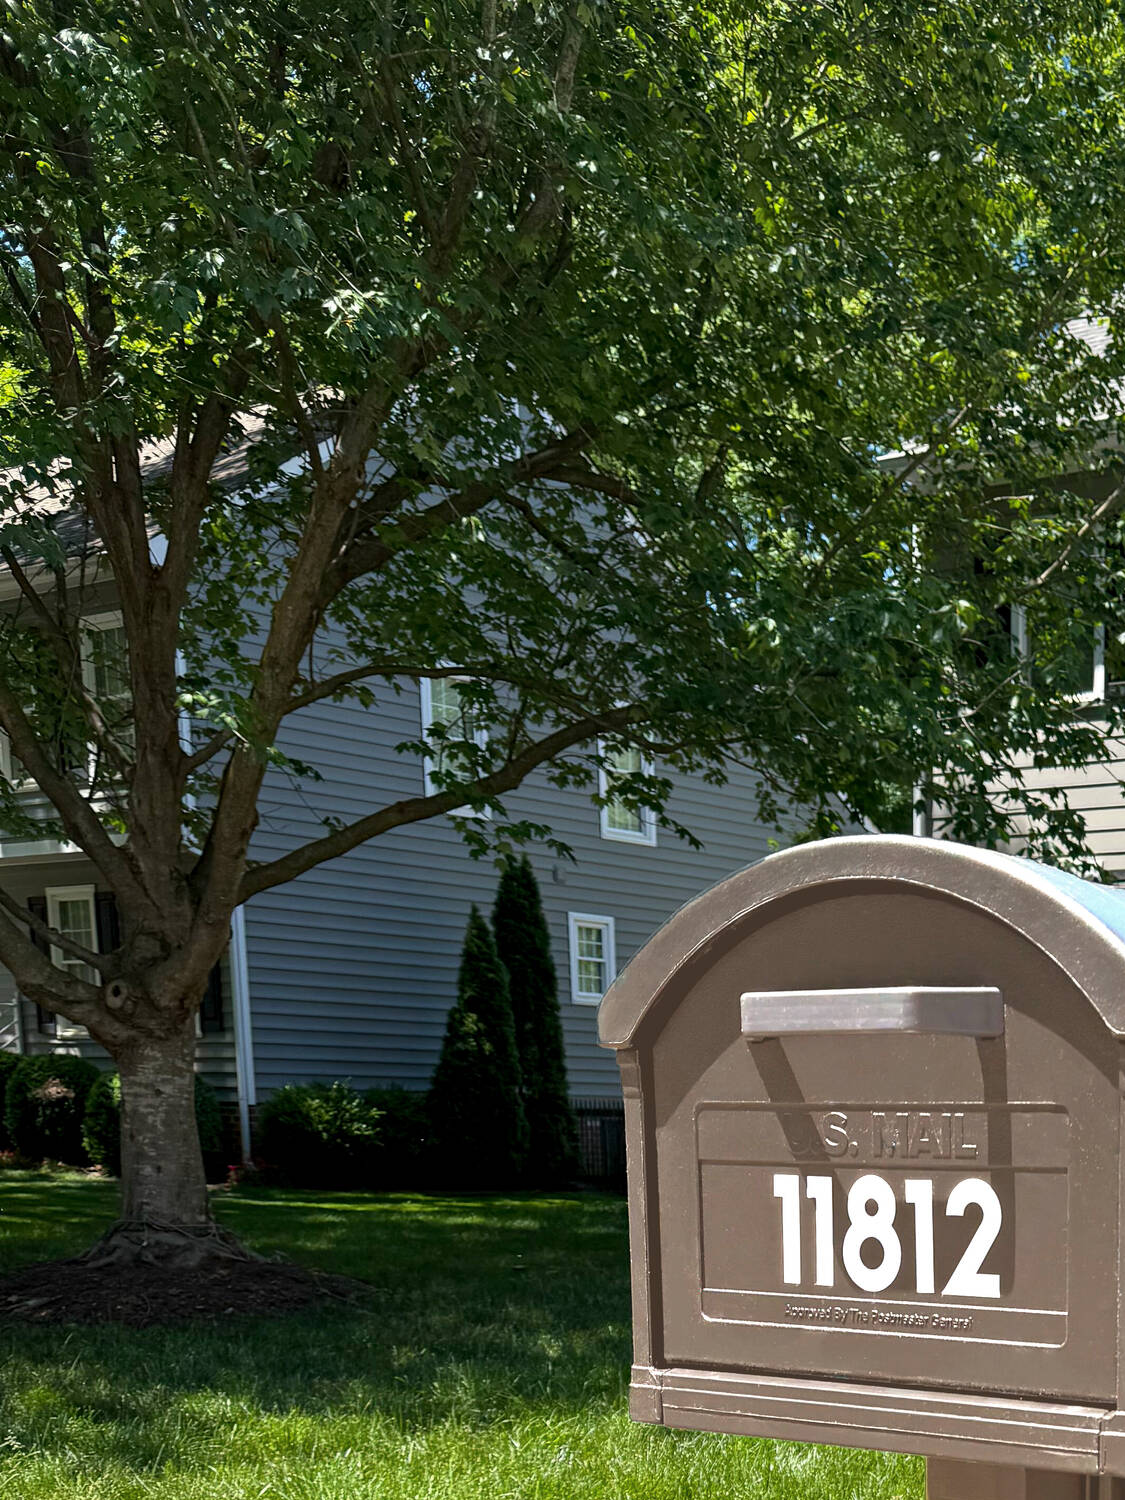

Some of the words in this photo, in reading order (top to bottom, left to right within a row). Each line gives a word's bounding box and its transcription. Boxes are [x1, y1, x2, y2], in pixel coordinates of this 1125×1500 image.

[872, 1111, 978, 1160] MAIL
[773, 1173, 1003, 1299] 11812
[784, 1303, 832, 1321] Approved
[833, 1305, 848, 1325] By
[848, 1307, 869, 1323] The
[871, 1309, 930, 1329] Postmaster
[932, 1312, 974, 1332] General
